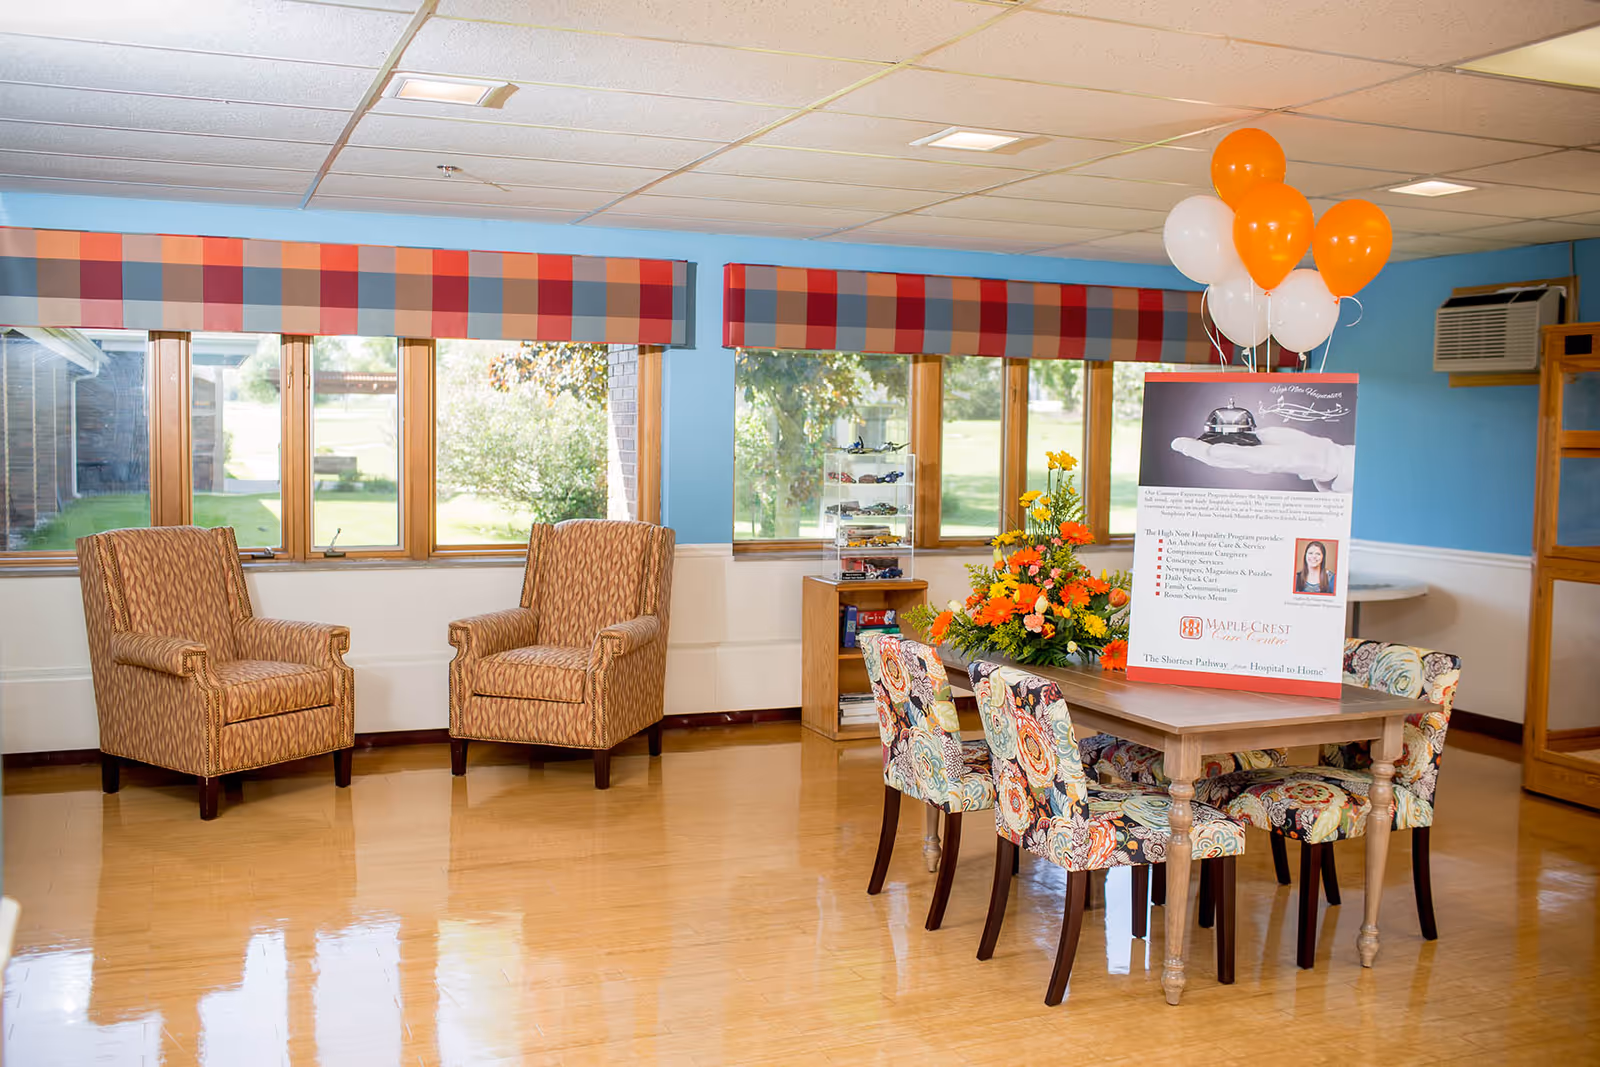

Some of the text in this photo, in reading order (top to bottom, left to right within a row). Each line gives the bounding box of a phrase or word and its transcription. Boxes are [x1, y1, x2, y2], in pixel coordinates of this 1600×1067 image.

[1144, 528, 1156, 536] The
[1157, 529, 1174, 538] High
[1191, 530, 1226, 540] Hospitality
[1227, 532, 1255, 541] Program
[1178, 539, 1207, 547] Advocate
[1242, 542, 1266, 550] Service
[1166, 547, 1248, 559] Compassionate Caregivers
[1165, 556, 1224, 566] Concierge Services
[1205, 567, 1239, 576] Magazines
[1165, 573, 1181, 582] Daily
[1164, 582, 1238, 594] Family Communication
[1164, 591, 1227, 602] Room Service Menu
[1206, 618, 1292, 635] MAPLE CREST
[1143, 653, 1159, 663] The
[1161, 655, 1193, 666] Shortest
[1195, 657, 1228, 671] Pathway
[1250, 662, 1285, 674] Hospital
